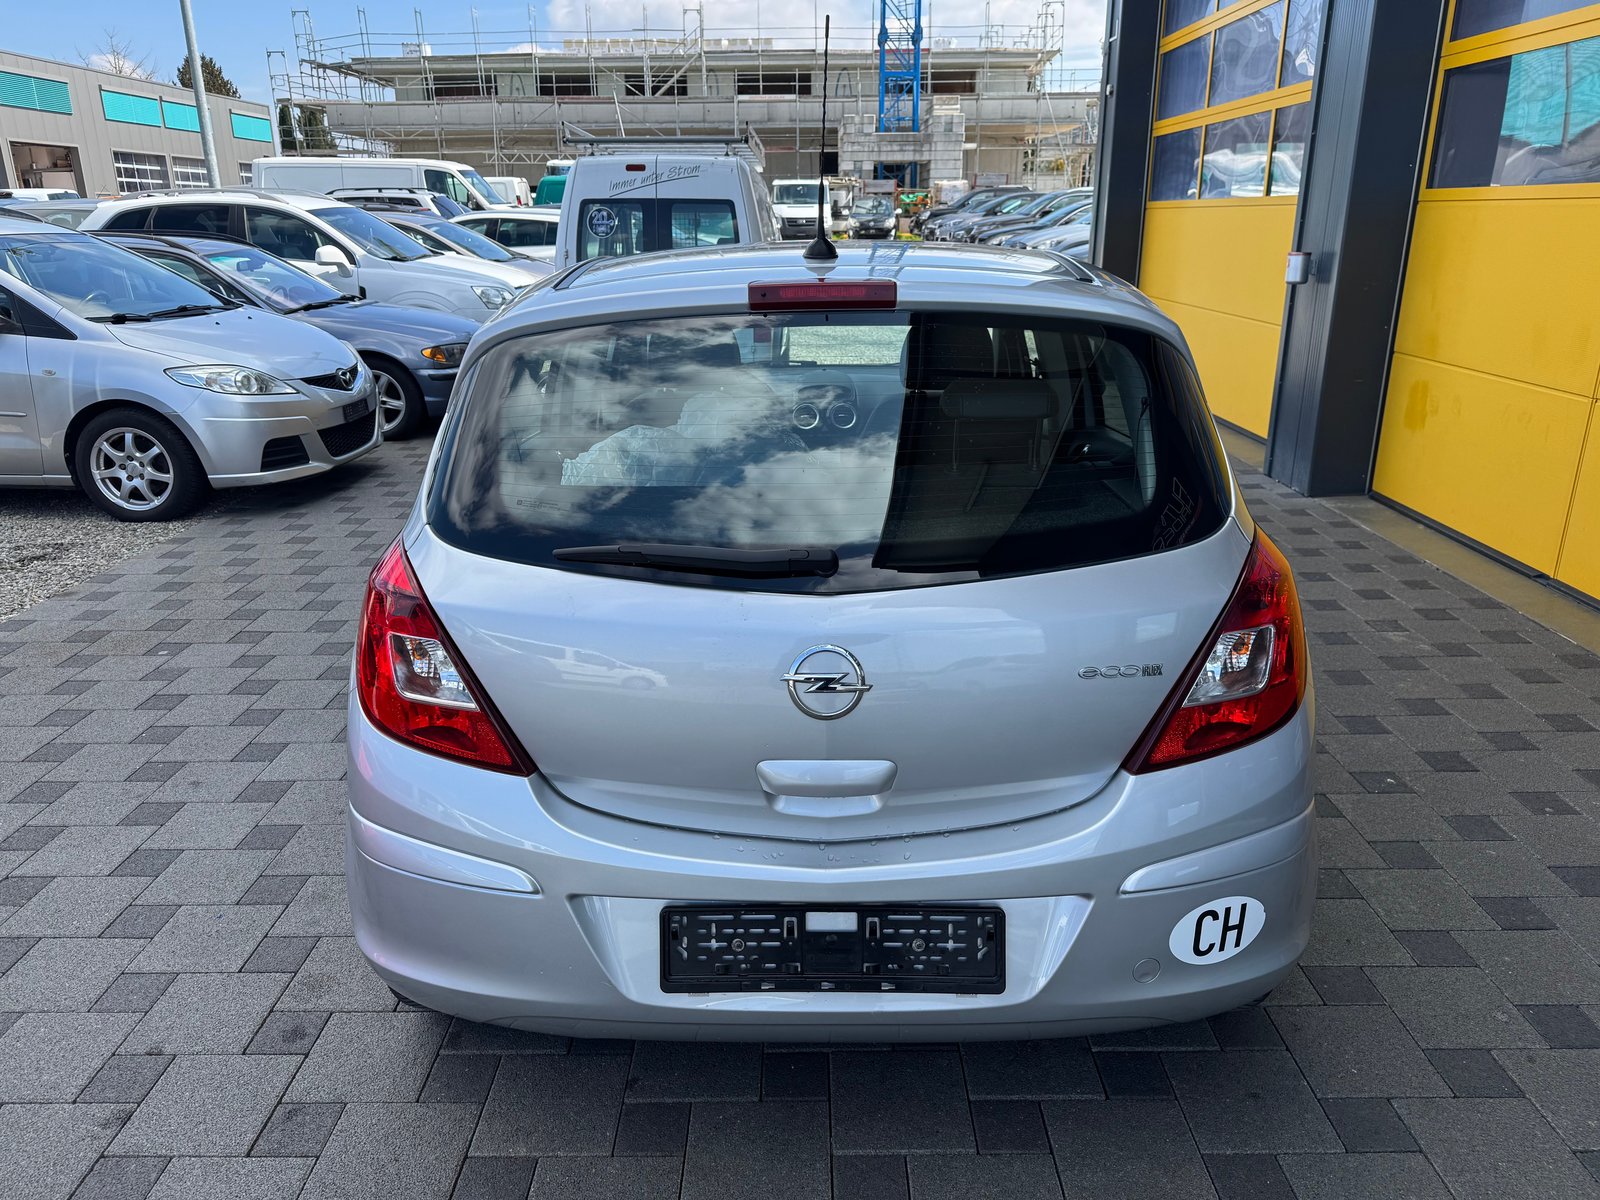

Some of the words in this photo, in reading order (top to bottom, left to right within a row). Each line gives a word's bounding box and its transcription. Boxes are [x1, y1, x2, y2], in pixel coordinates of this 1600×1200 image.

[608, 178, 637, 192] Immer
[640, 171, 664, 184] unter
[1192, 902, 1248, 957] CH
